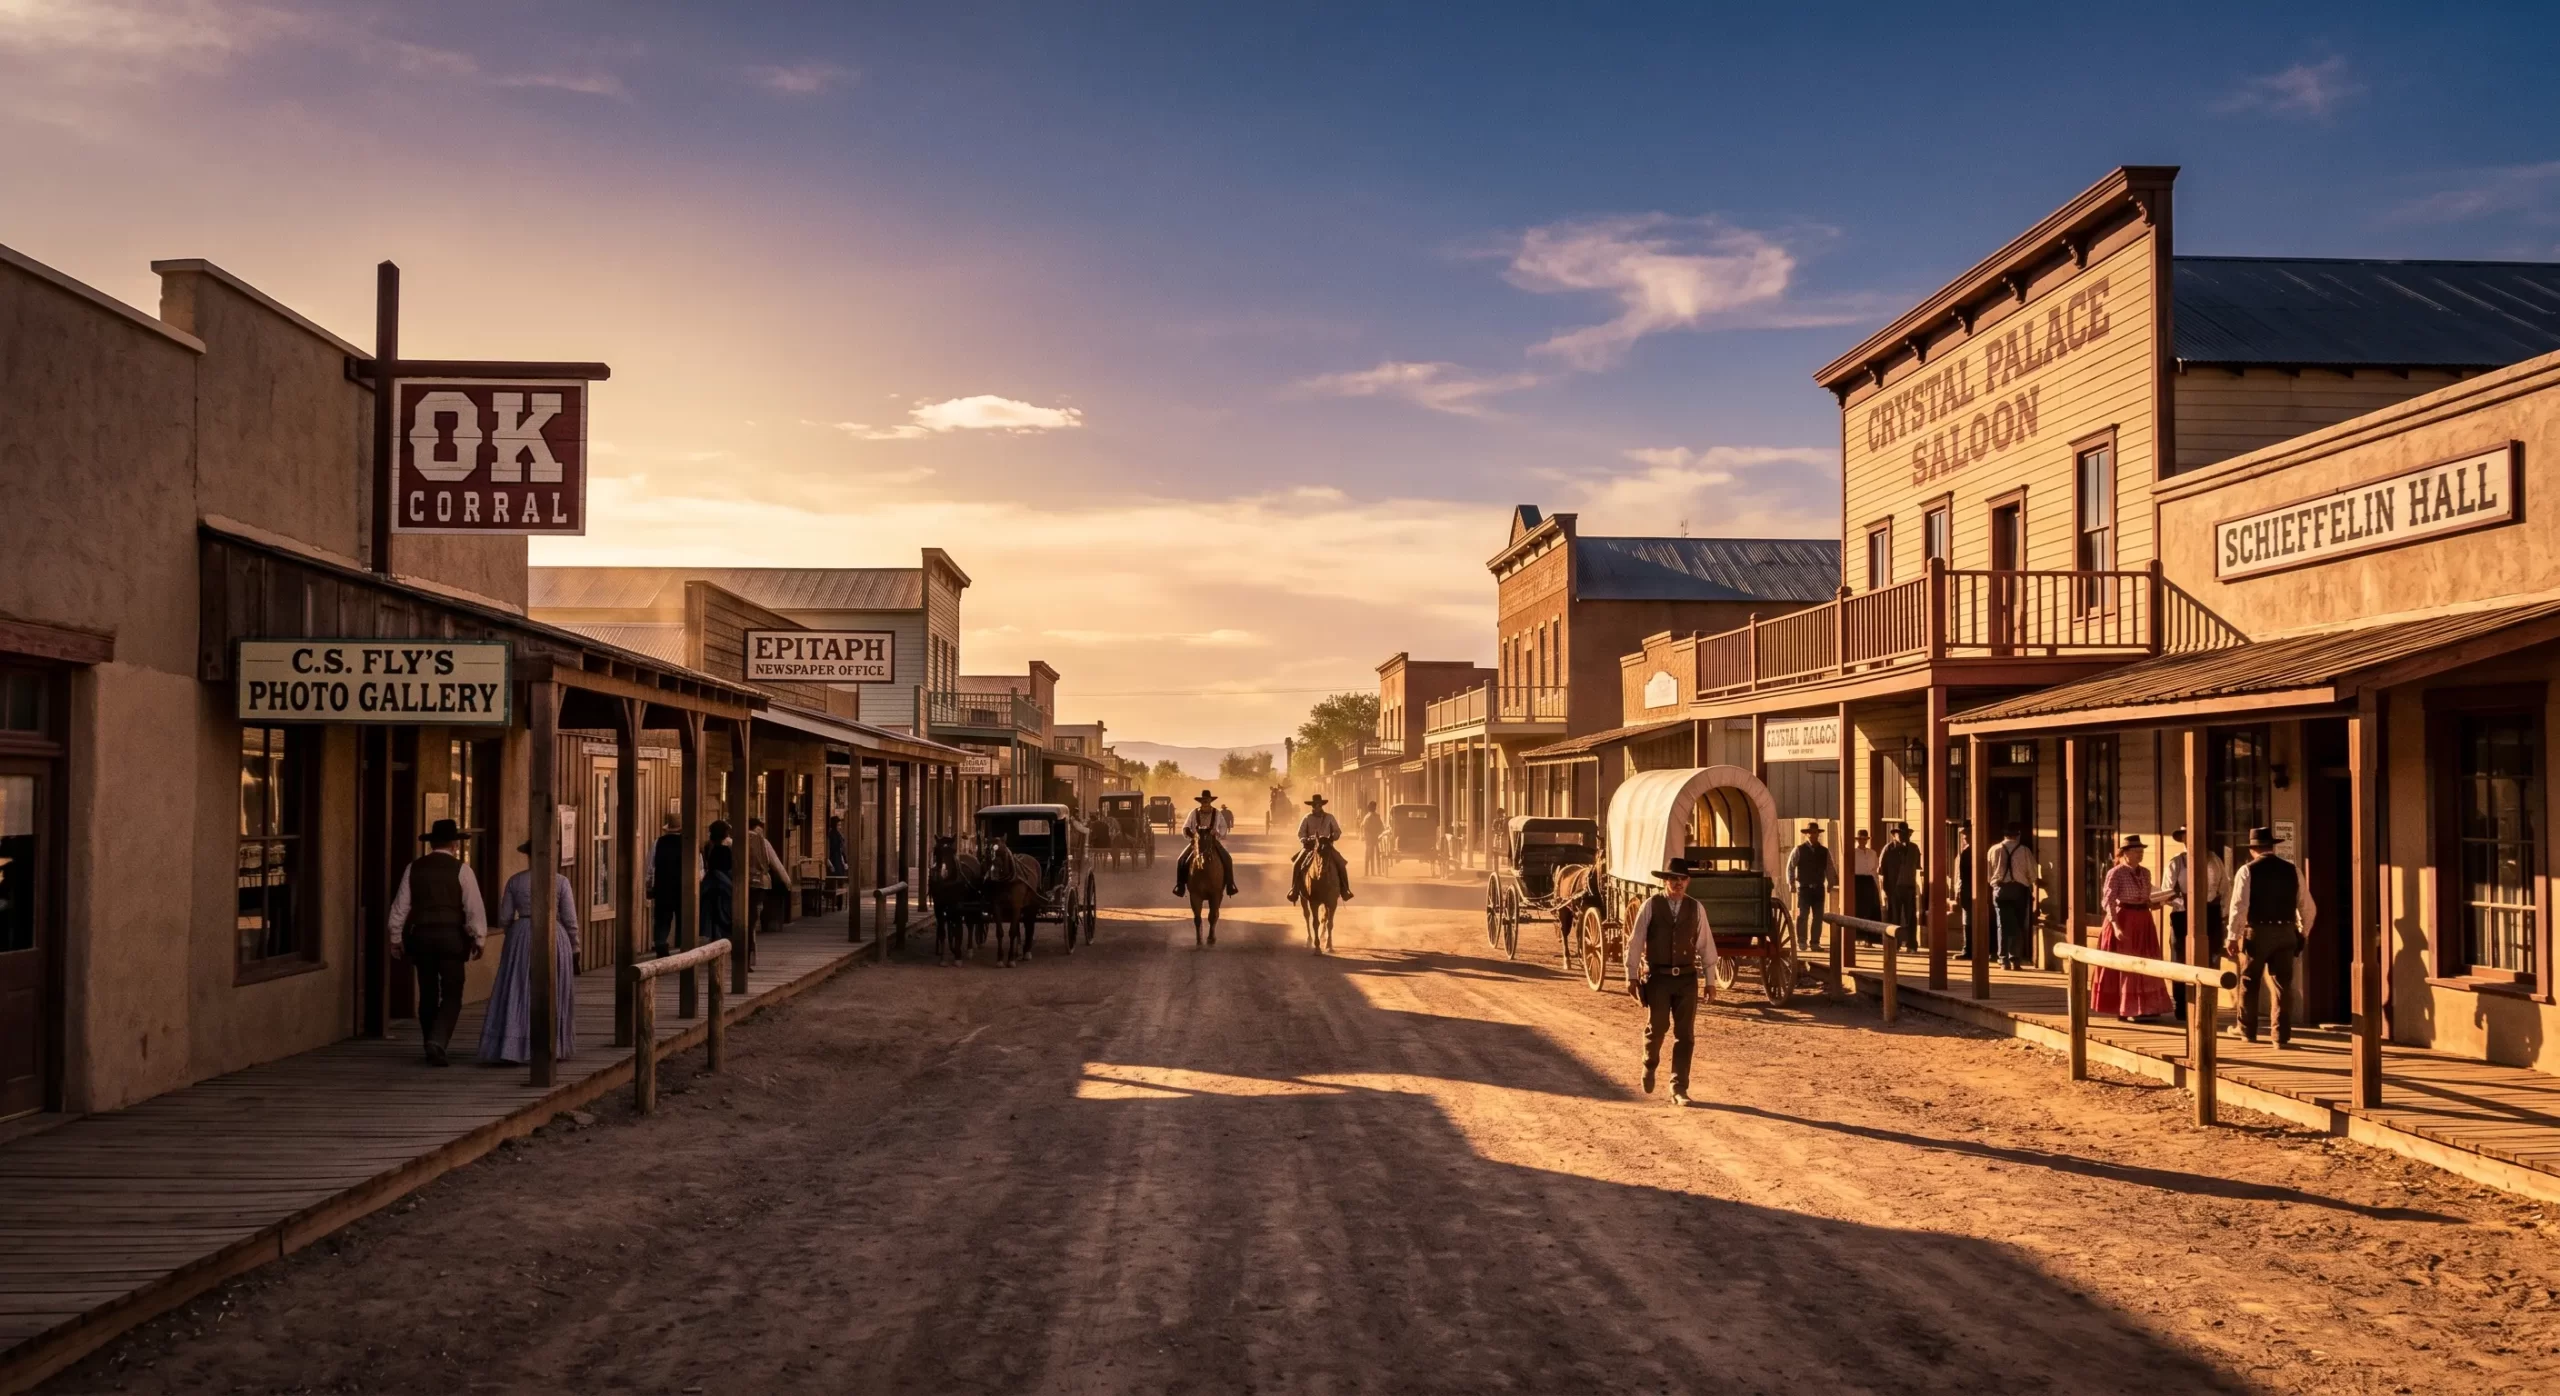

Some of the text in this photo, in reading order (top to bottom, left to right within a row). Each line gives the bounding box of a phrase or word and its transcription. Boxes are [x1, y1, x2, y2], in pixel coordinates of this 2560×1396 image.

[1868, 277, 2110, 454] CRYSTAL PALACE
[409, 391, 563, 483] OK
[1912, 384, 2040, 488] SALOON
[409, 490, 567, 523] CORRAL
[2225, 462, 2497, 568] SCHIEFFELIN HALL
[292, 648, 454, 675] C.S. FLY'S
[755, 637, 885, 661] EPITAPH
[755, 664, 885, 676] NEWSPAPER OFFICE
[248, 681, 498, 713] PHOTO GALLERY
